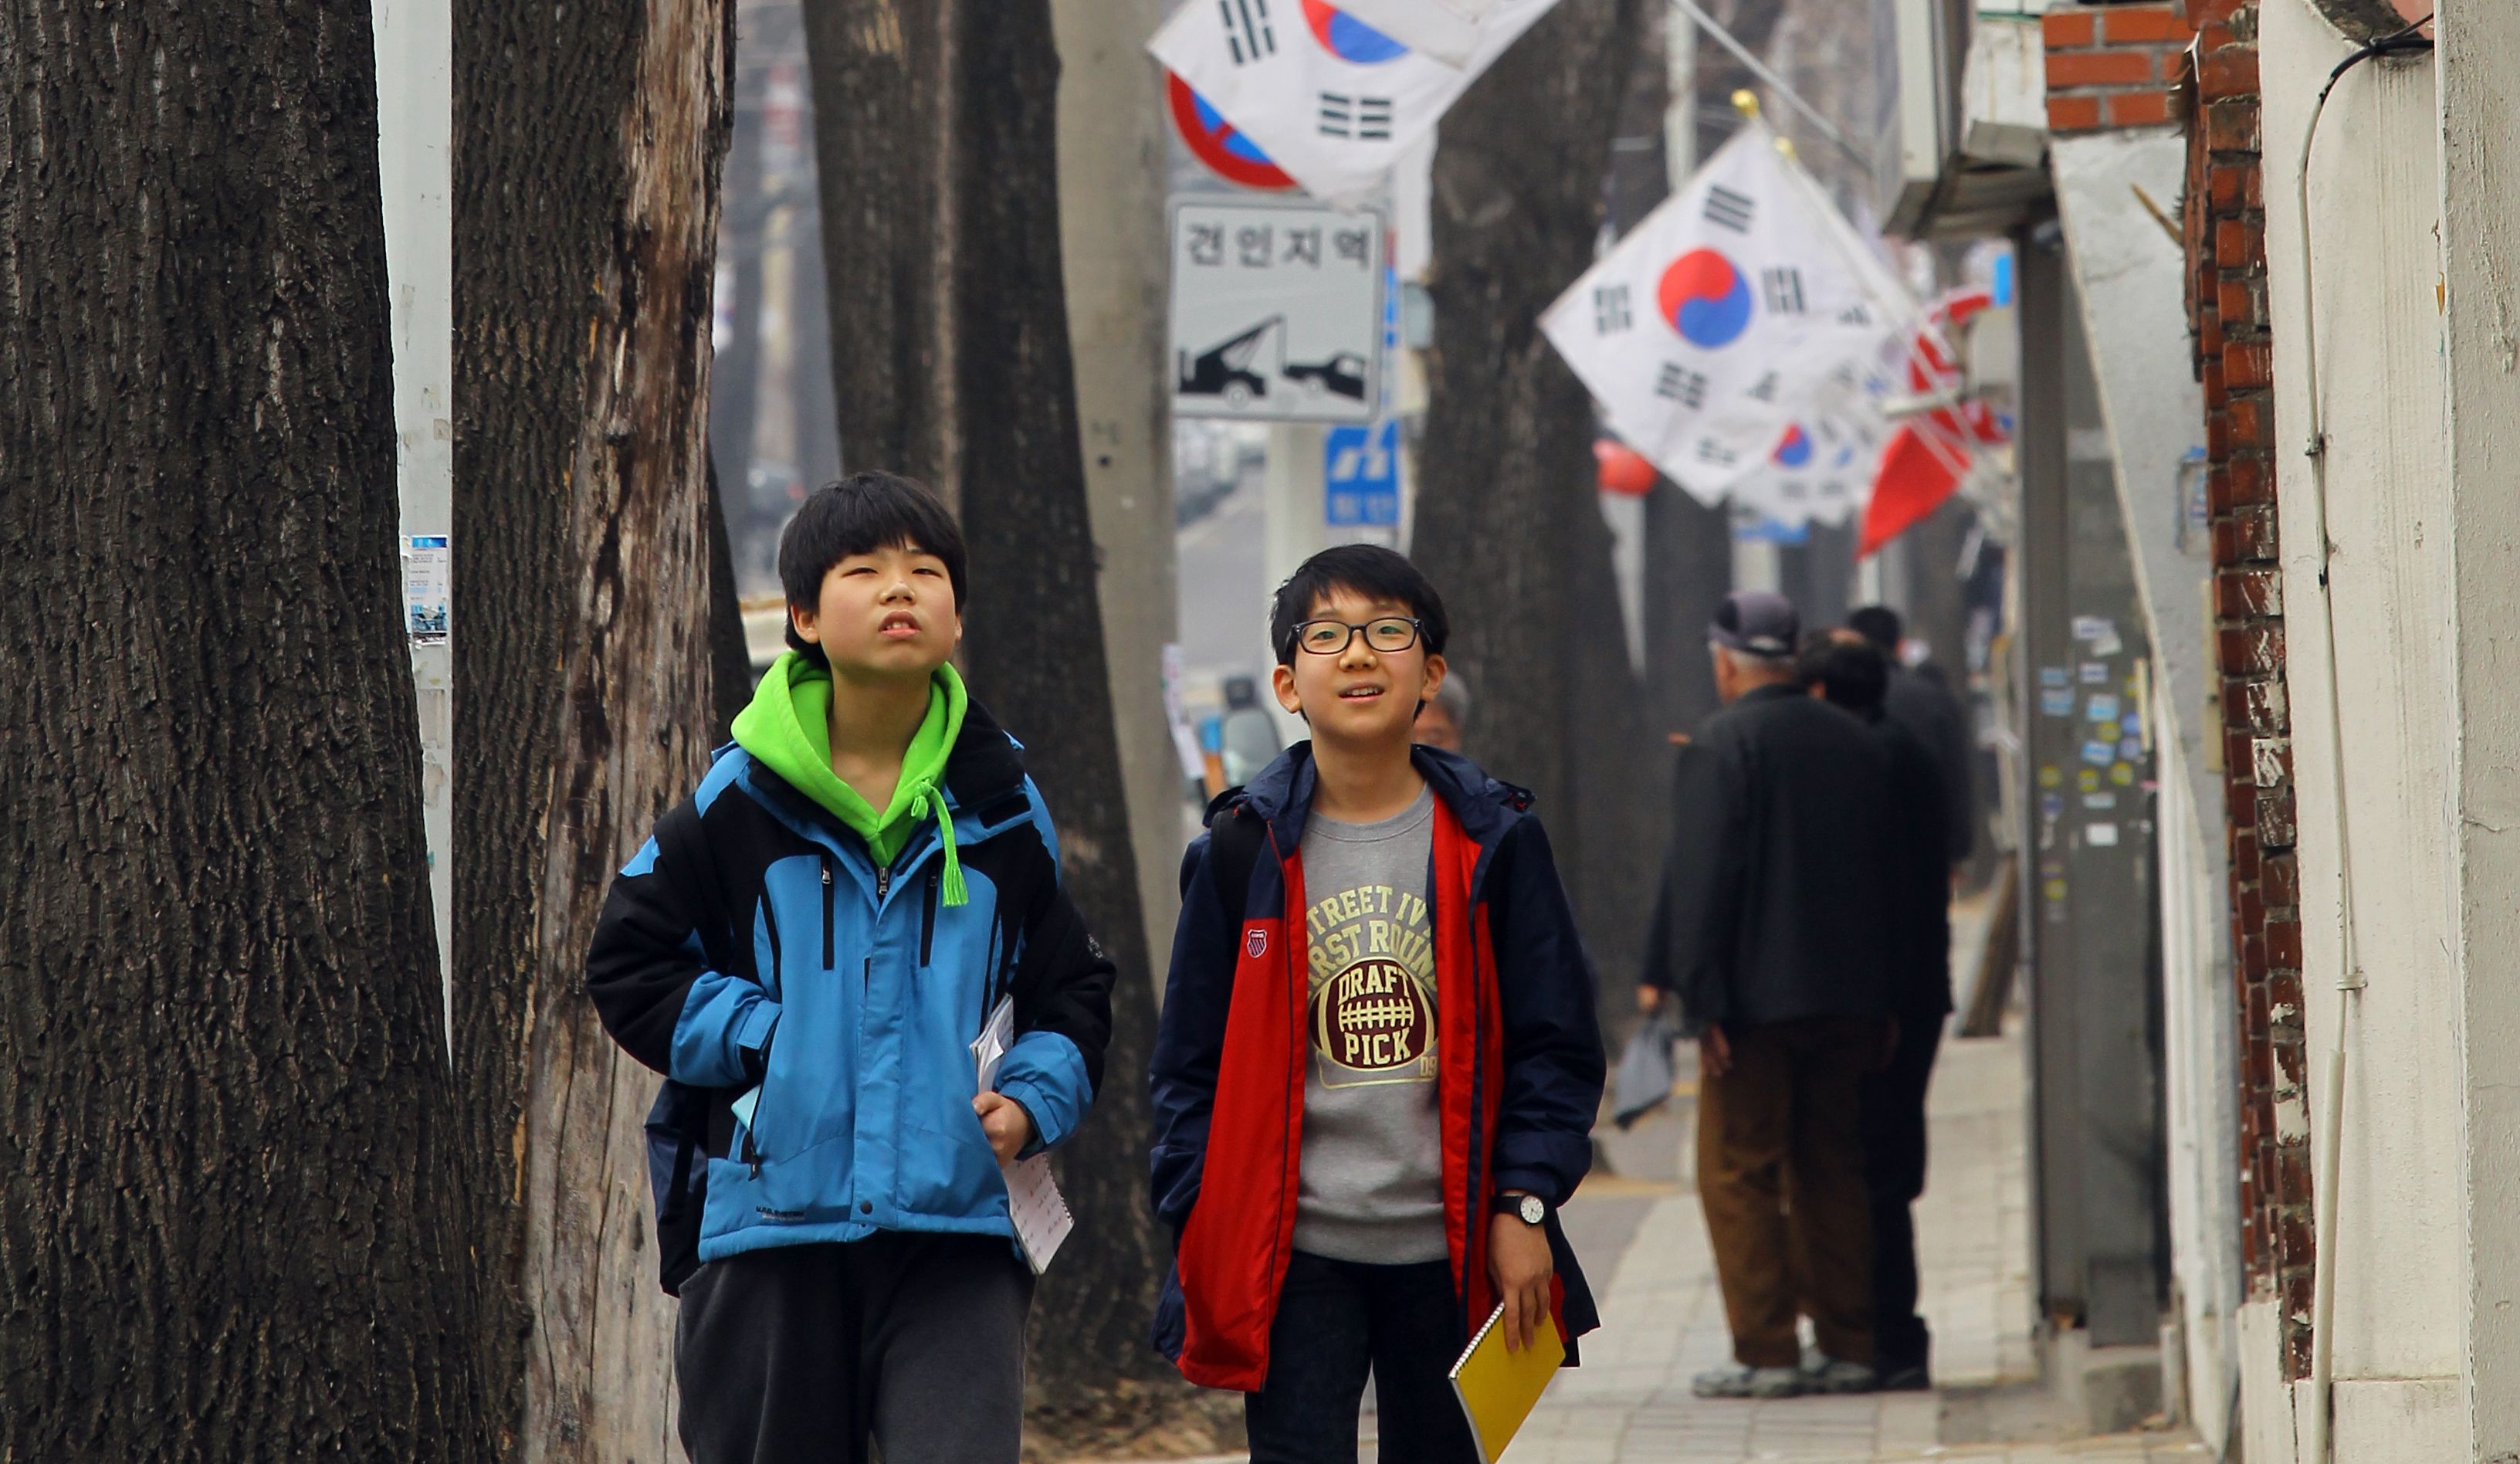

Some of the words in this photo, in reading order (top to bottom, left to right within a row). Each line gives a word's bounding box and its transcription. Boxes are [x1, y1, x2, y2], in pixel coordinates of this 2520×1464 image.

[1187, 223, 1370, 269] 견인지역
[1306, 885, 1393, 945] TREET
[1395, 893, 1431, 938] IV
[1369, 920, 1437, 991] ROUN
[1337, 964, 1411, 1006] DRAFT
[1344, 1027, 1411, 1066] PICK
